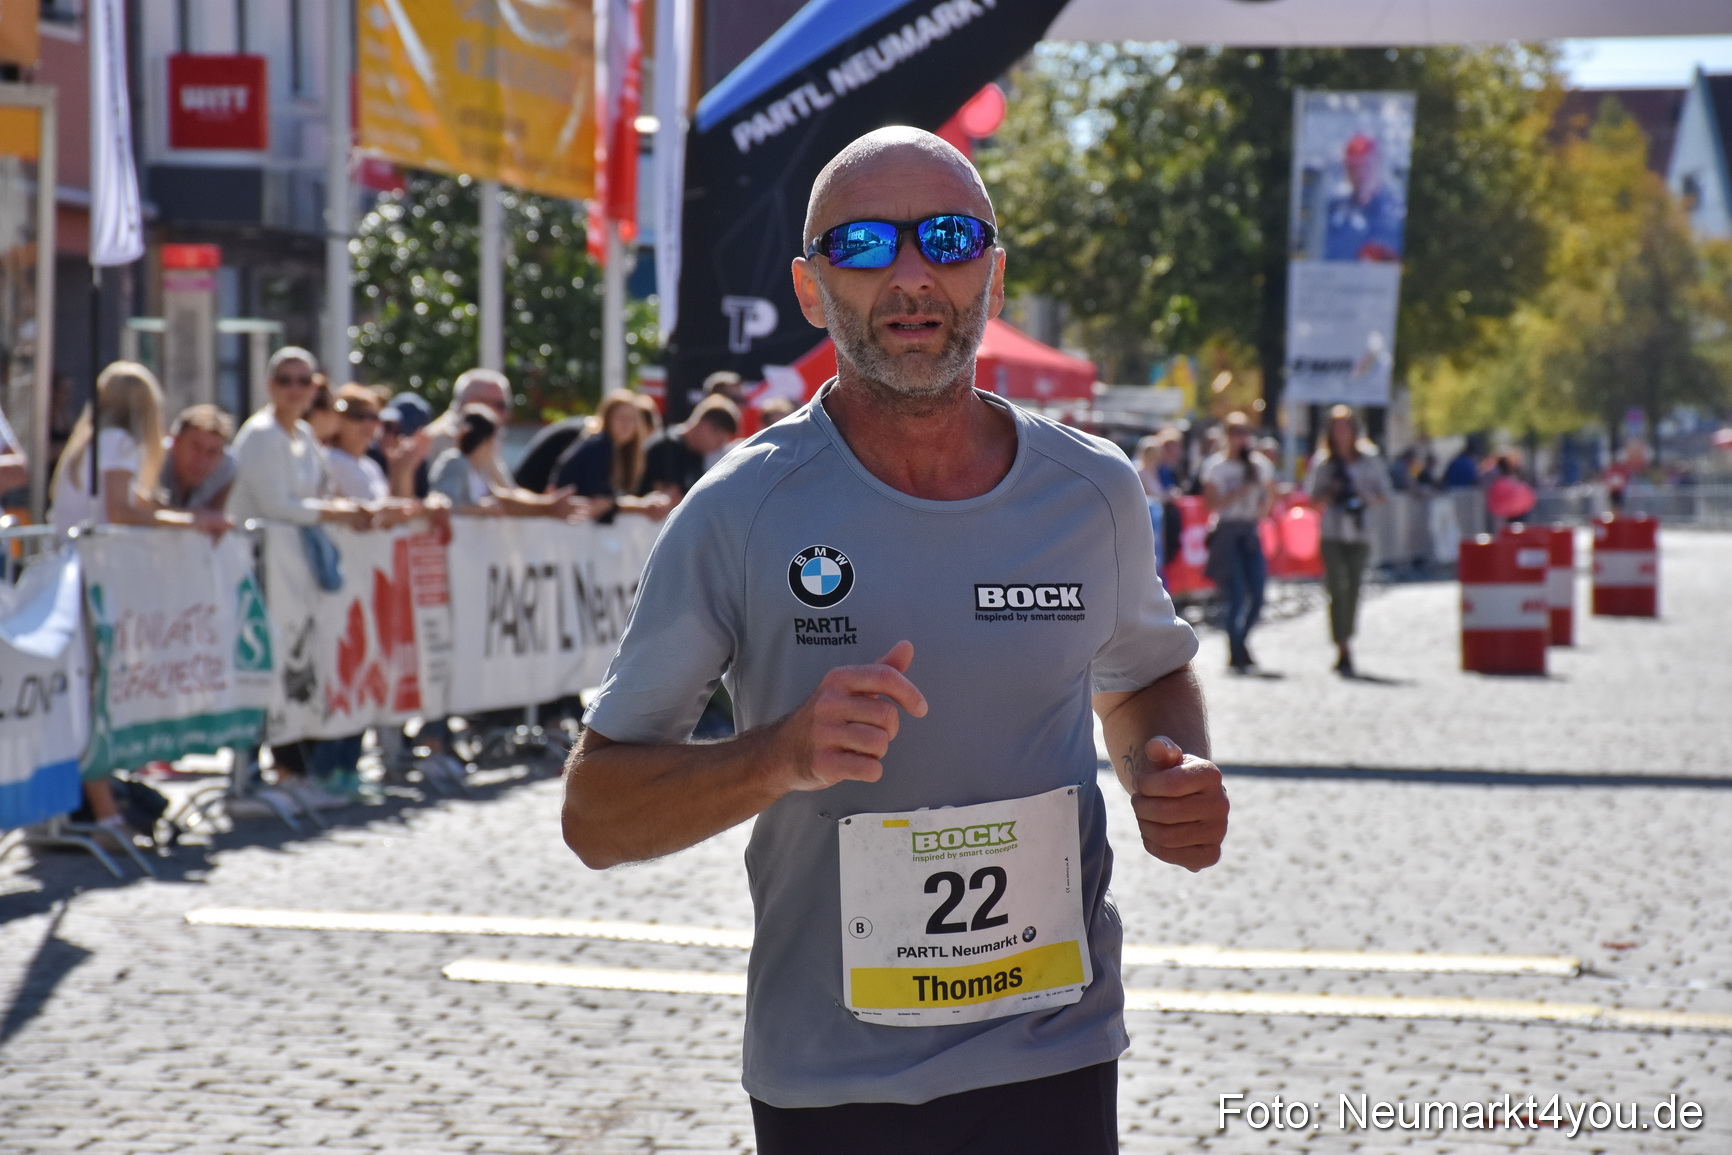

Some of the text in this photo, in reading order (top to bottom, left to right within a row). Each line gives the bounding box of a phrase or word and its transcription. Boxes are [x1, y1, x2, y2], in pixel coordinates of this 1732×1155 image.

[731, 82, 835, 153] PARTL
[794, 547, 848, 567] BMW
[974, 583, 1085, 611] BOCK
[485, 562, 572, 657] PARTL
[975, 612, 1085, 622] inspired by smart concepts
[794, 616, 857, 633] PARTL
[796, 633, 857, 646] Neumarkt
[912, 821, 1017, 853] BOCK
[912, 842, 1018, 863] inspired by smart concepts
[924, 865, 1009, 935] 22
[856, 922, 865, 934] B
[897, 934, 1018, 958] PARTL Neumarkt
[912, 966, 1023, 1002] Thomas
